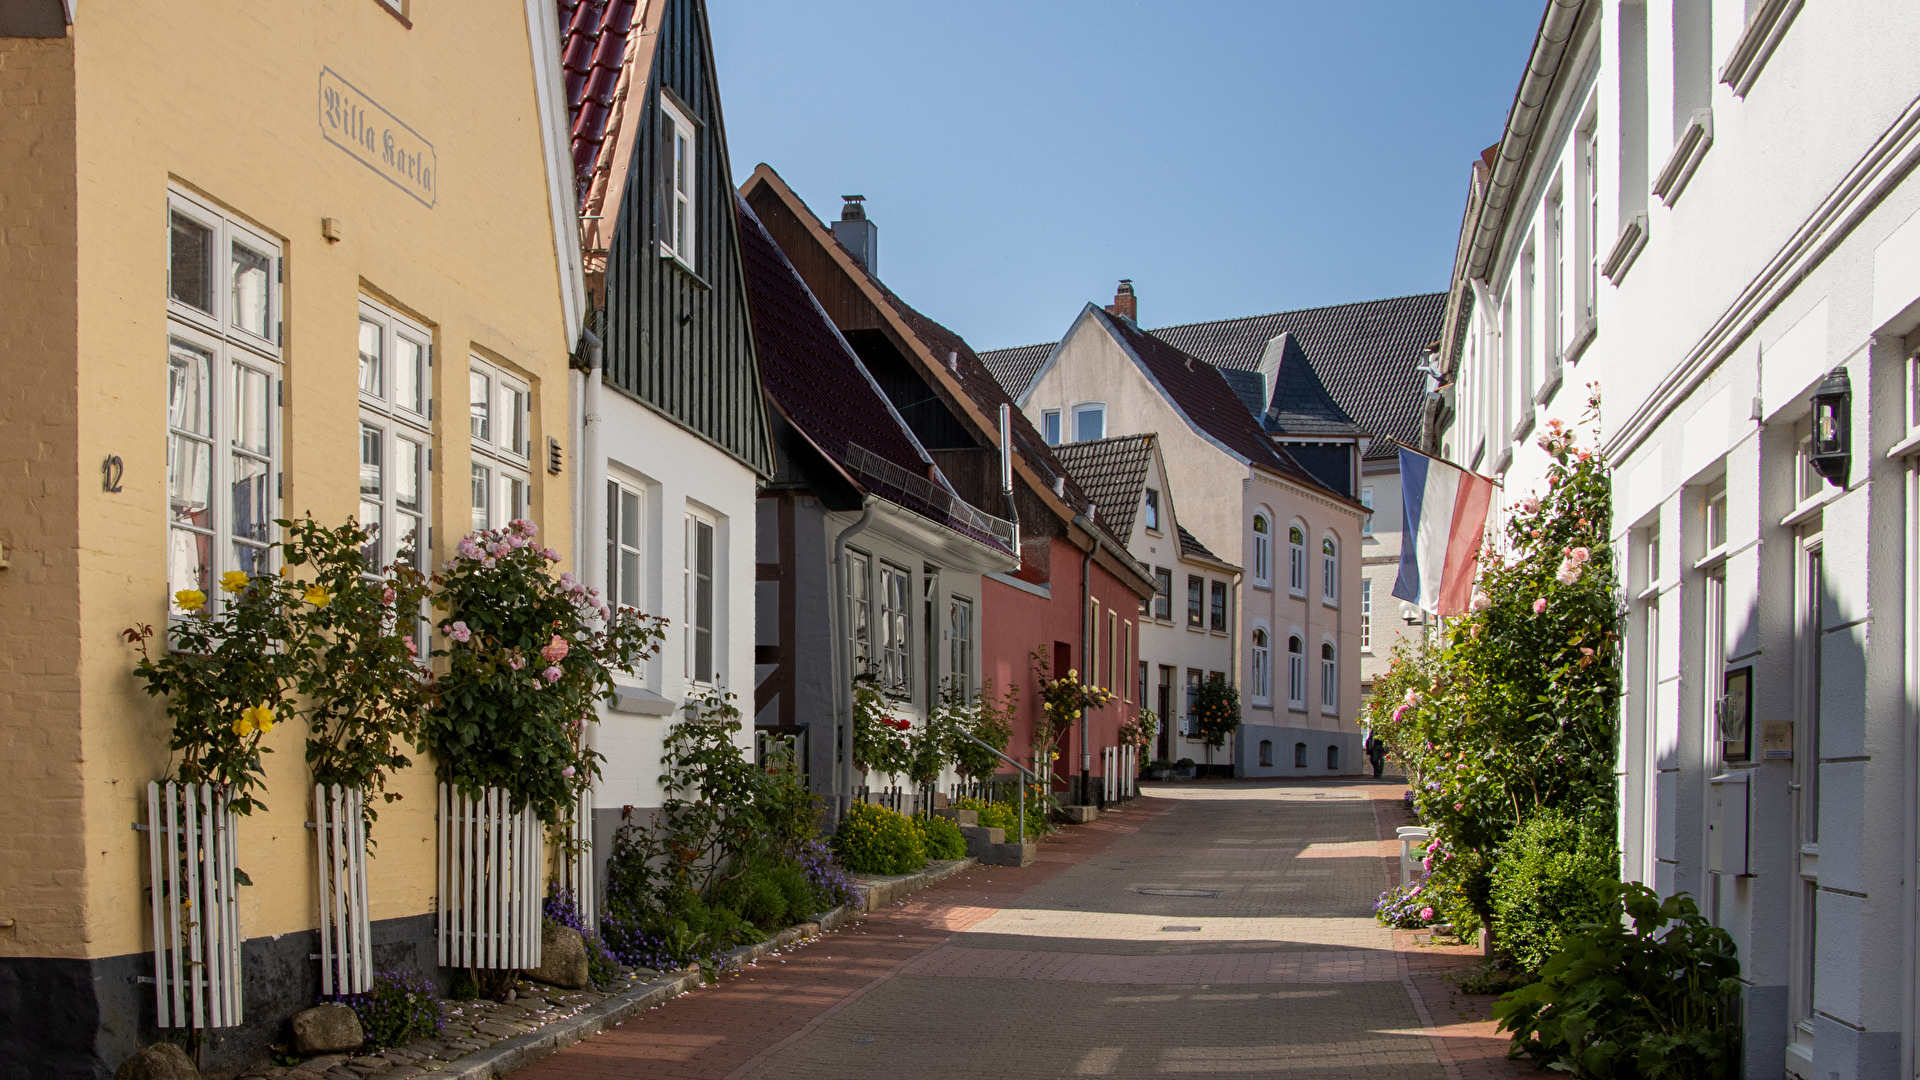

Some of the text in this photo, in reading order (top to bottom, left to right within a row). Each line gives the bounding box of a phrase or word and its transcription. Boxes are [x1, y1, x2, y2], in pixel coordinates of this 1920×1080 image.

[324, 85, 431, 192] Villa Karla
[103, 454, 123, 493] 12
